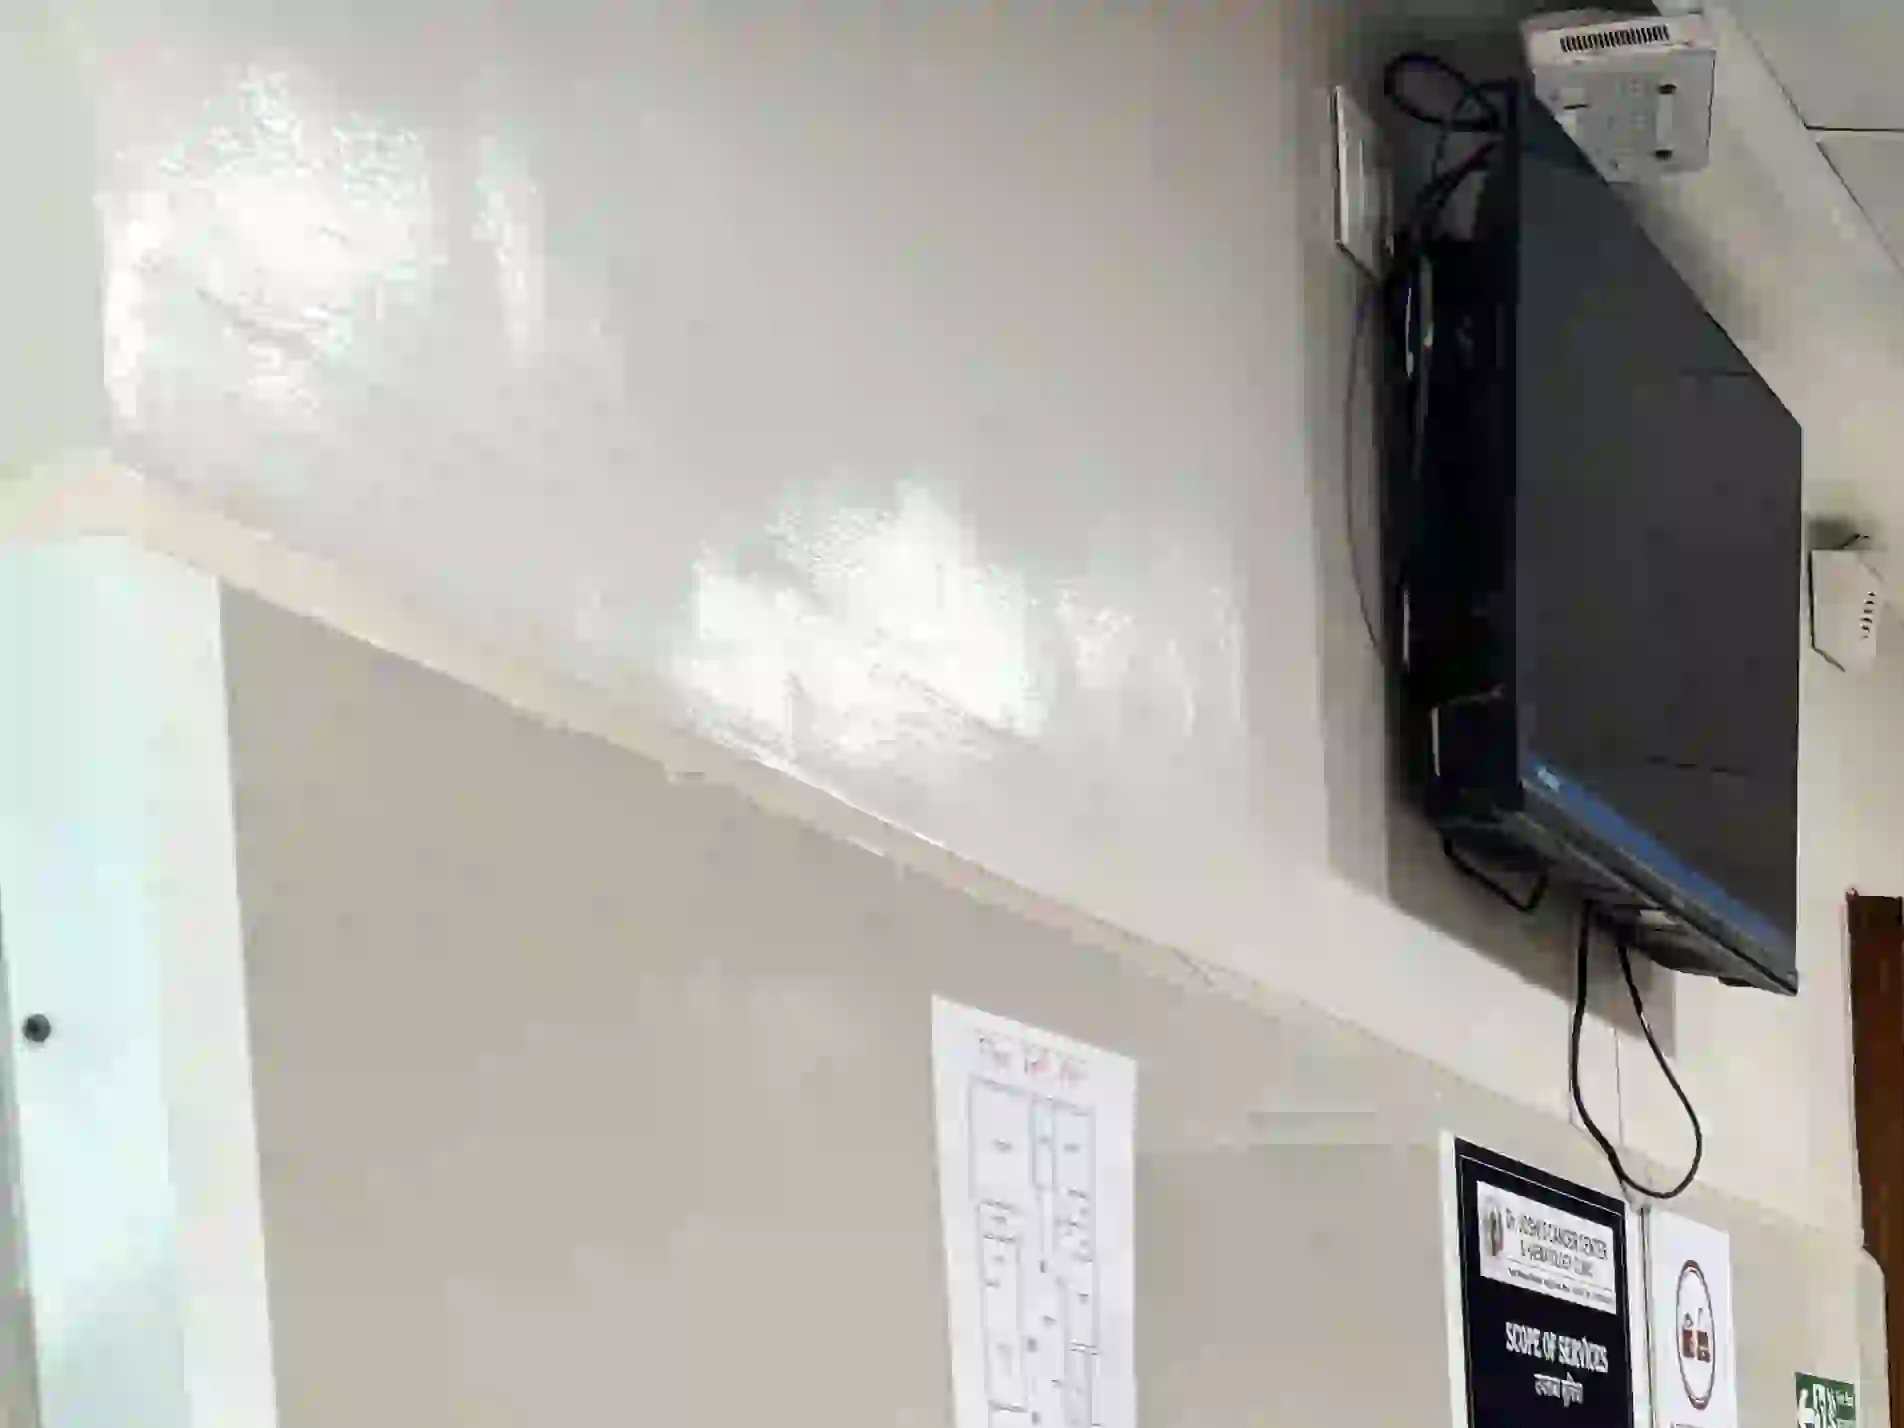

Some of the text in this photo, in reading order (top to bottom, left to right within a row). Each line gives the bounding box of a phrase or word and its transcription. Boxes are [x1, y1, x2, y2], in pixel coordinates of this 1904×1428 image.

[1505, 1321, 1609, 1373] SCOPE OF SERVICES
